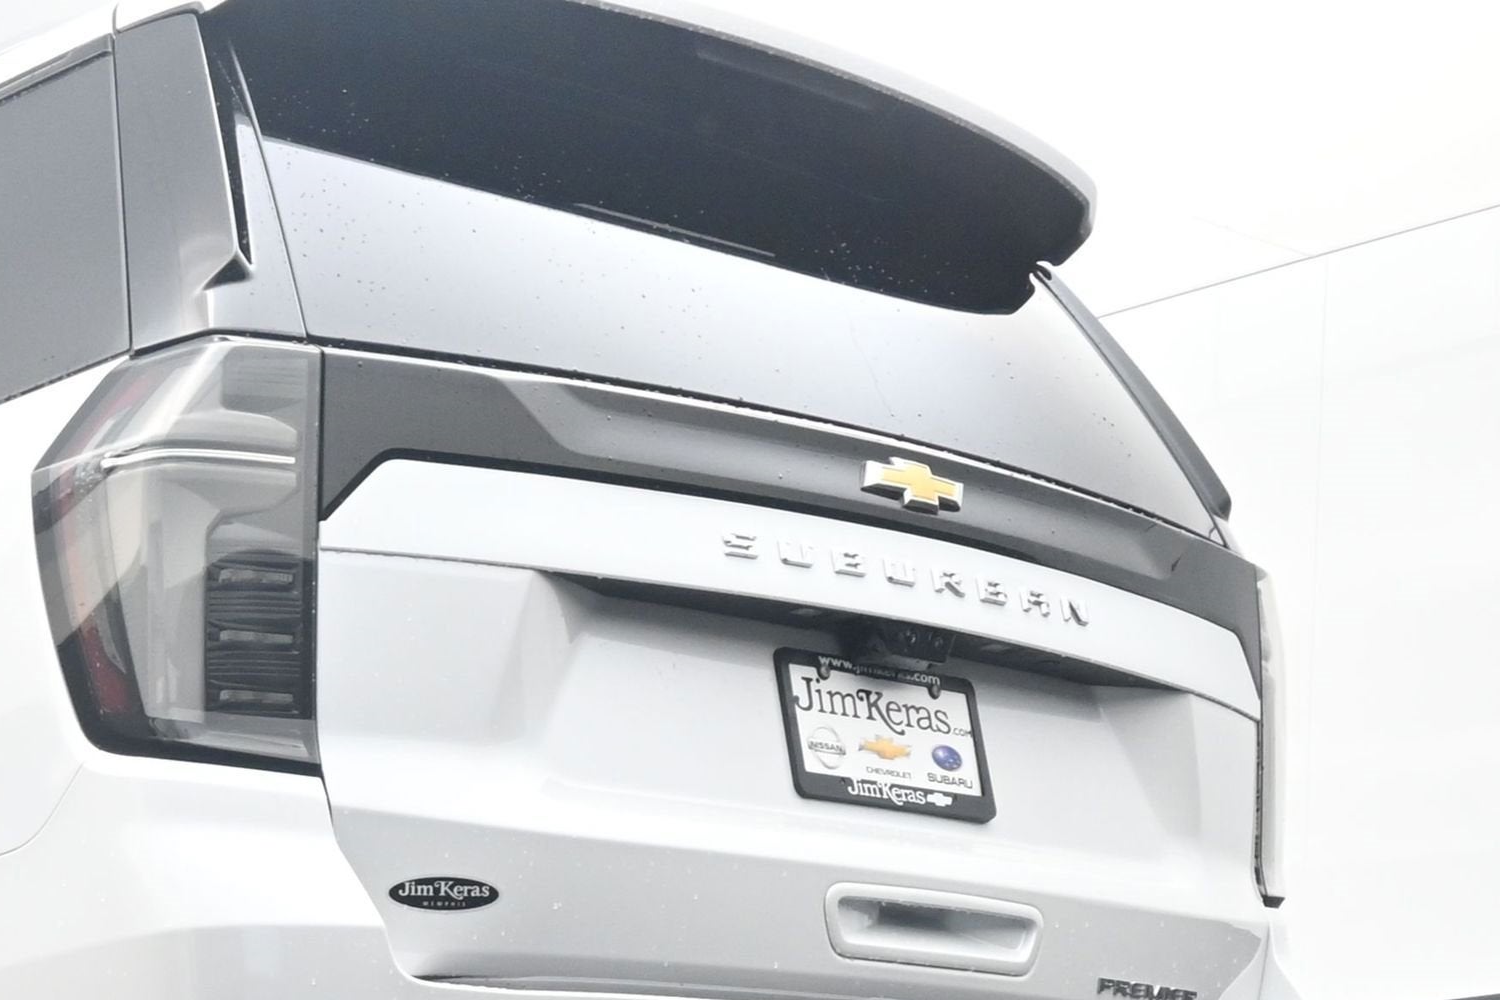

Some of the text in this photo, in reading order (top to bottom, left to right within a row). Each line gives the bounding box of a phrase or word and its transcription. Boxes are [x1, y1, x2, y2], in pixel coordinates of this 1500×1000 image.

[721, 532, 1090, 627] SUBURBAN
[808, 740, 843, 753] NISSAN
[866, 766, 912, 780] CHEVROLET
[927, 772, 973, 789] SUBARU
